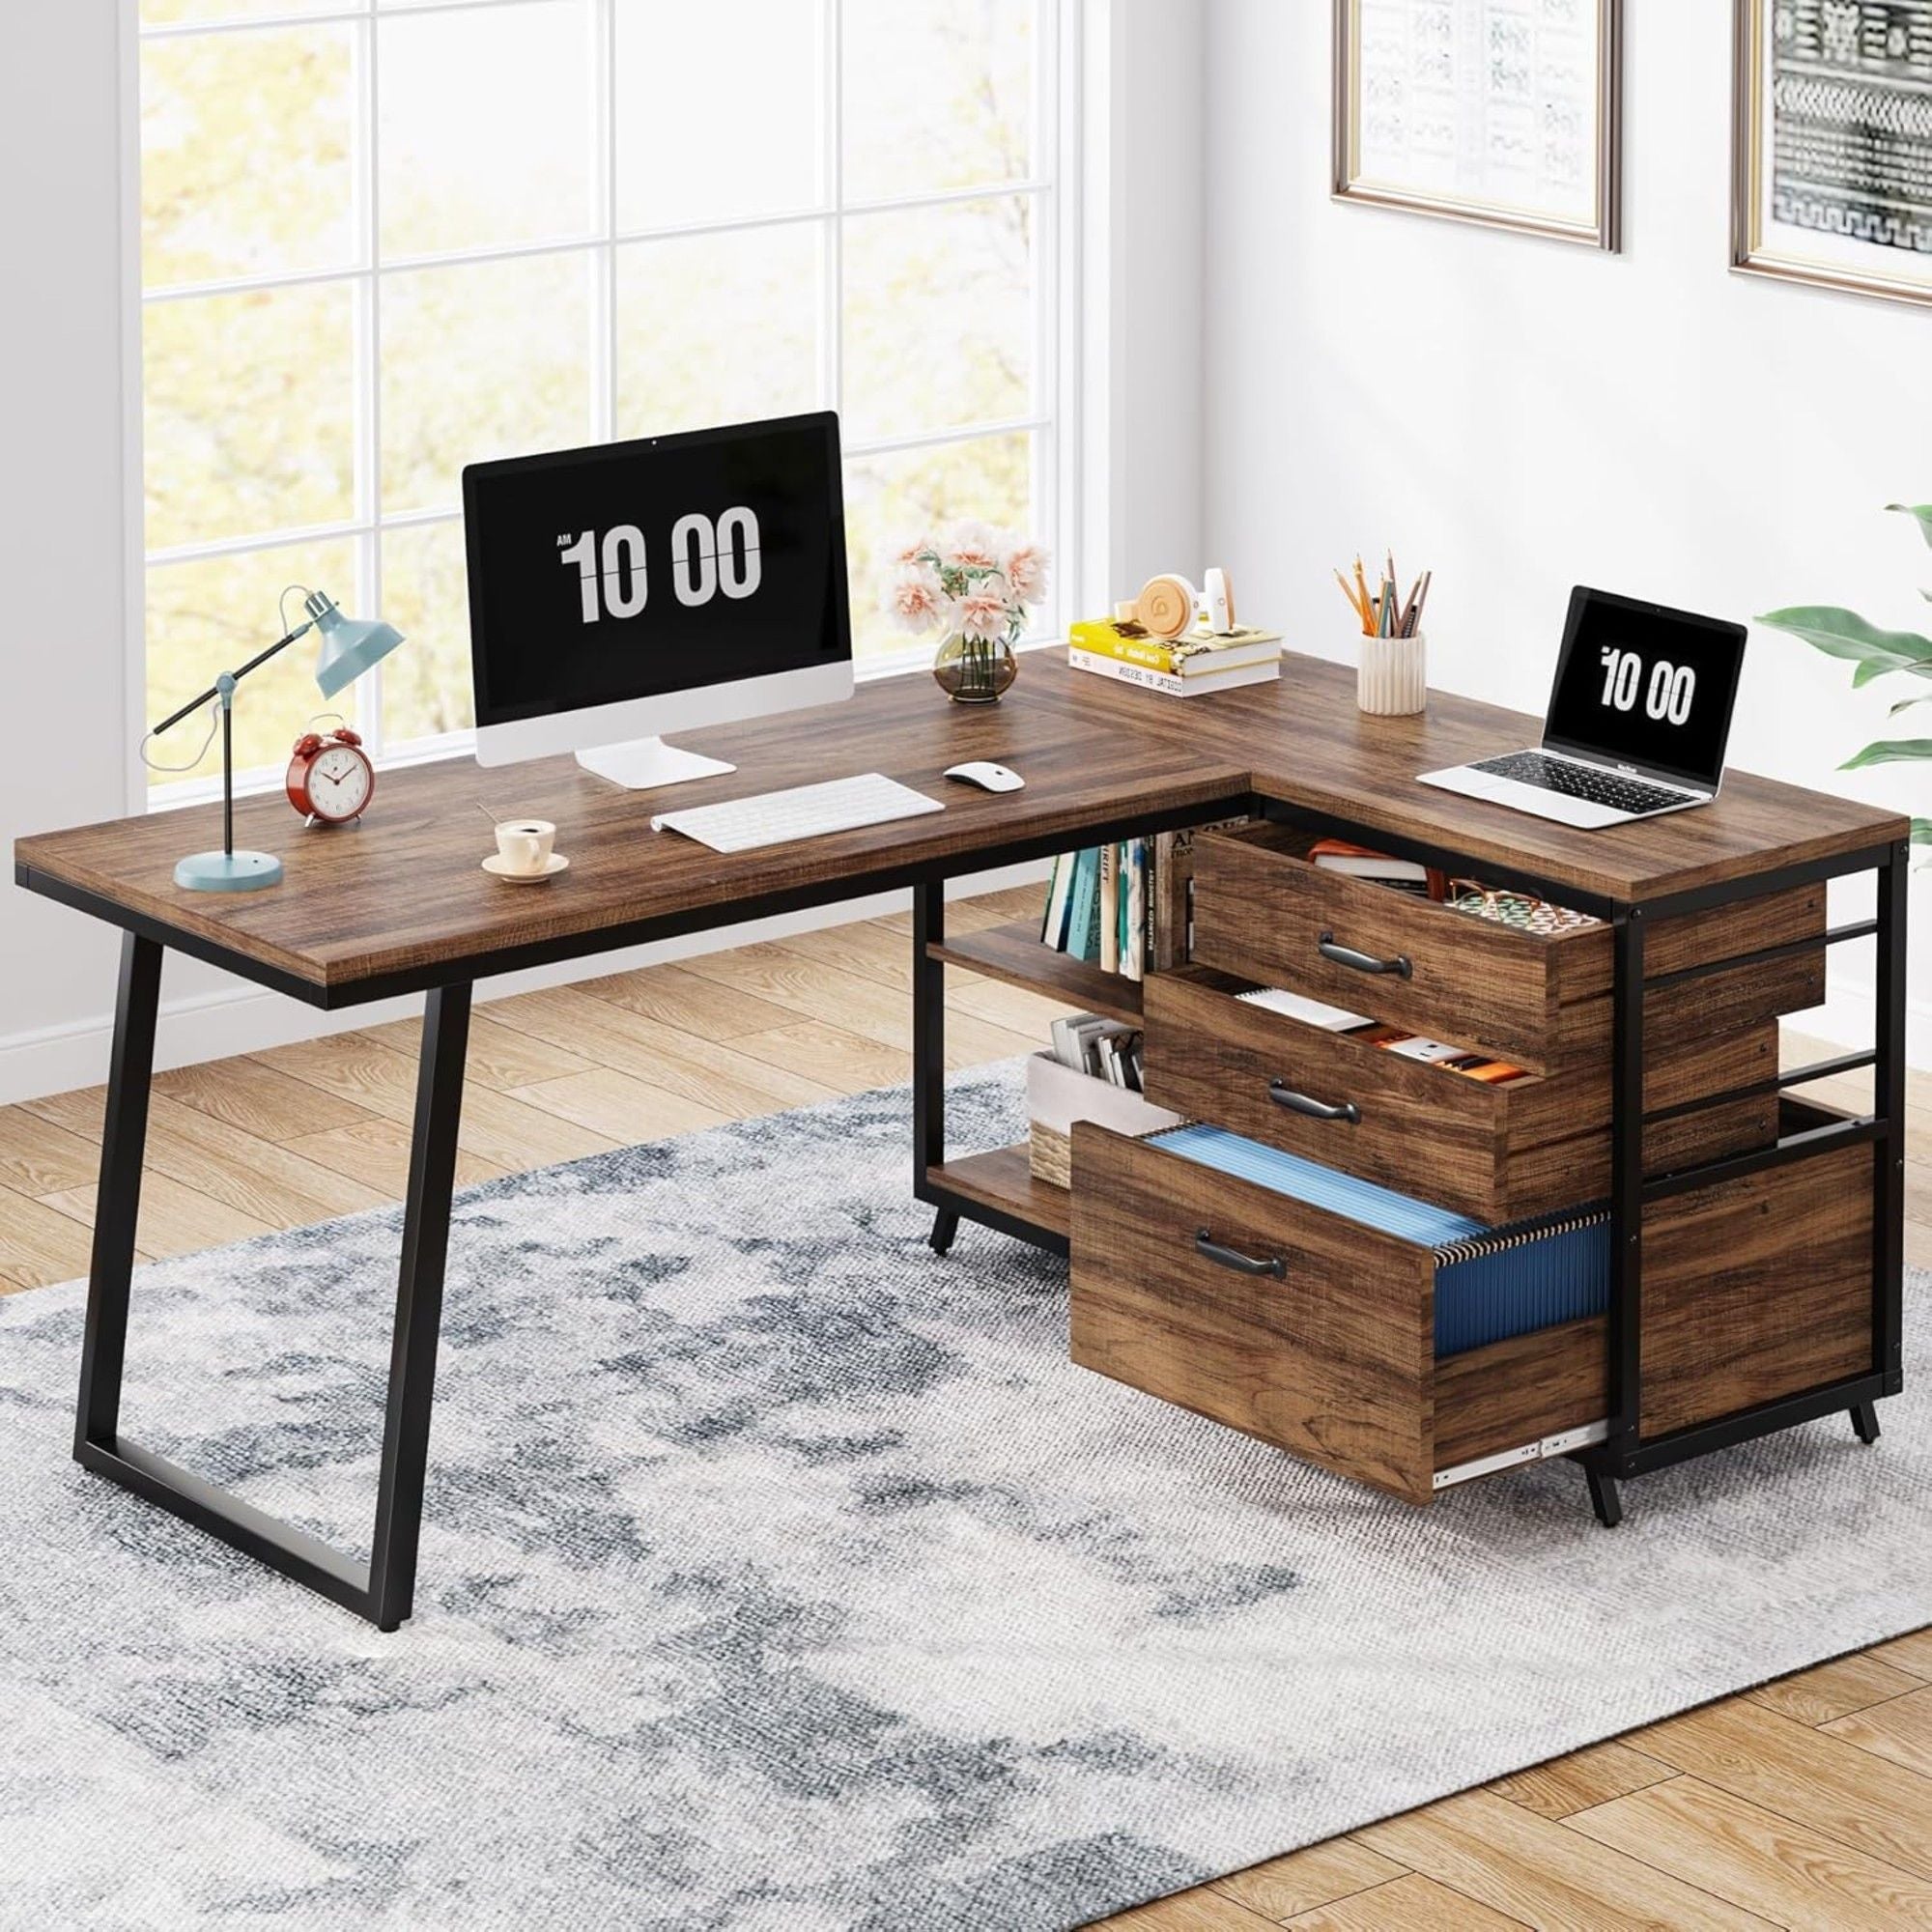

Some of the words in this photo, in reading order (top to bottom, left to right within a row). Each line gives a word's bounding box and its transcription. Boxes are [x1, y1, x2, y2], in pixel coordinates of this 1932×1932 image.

[557, 533, 572, 547] AM
[561, 525, 648, 624] 10
[671, 506, 761, 607] 00
[1601, 648, 1642, 712] 10
[1645, 660, 1696, 725] 00
